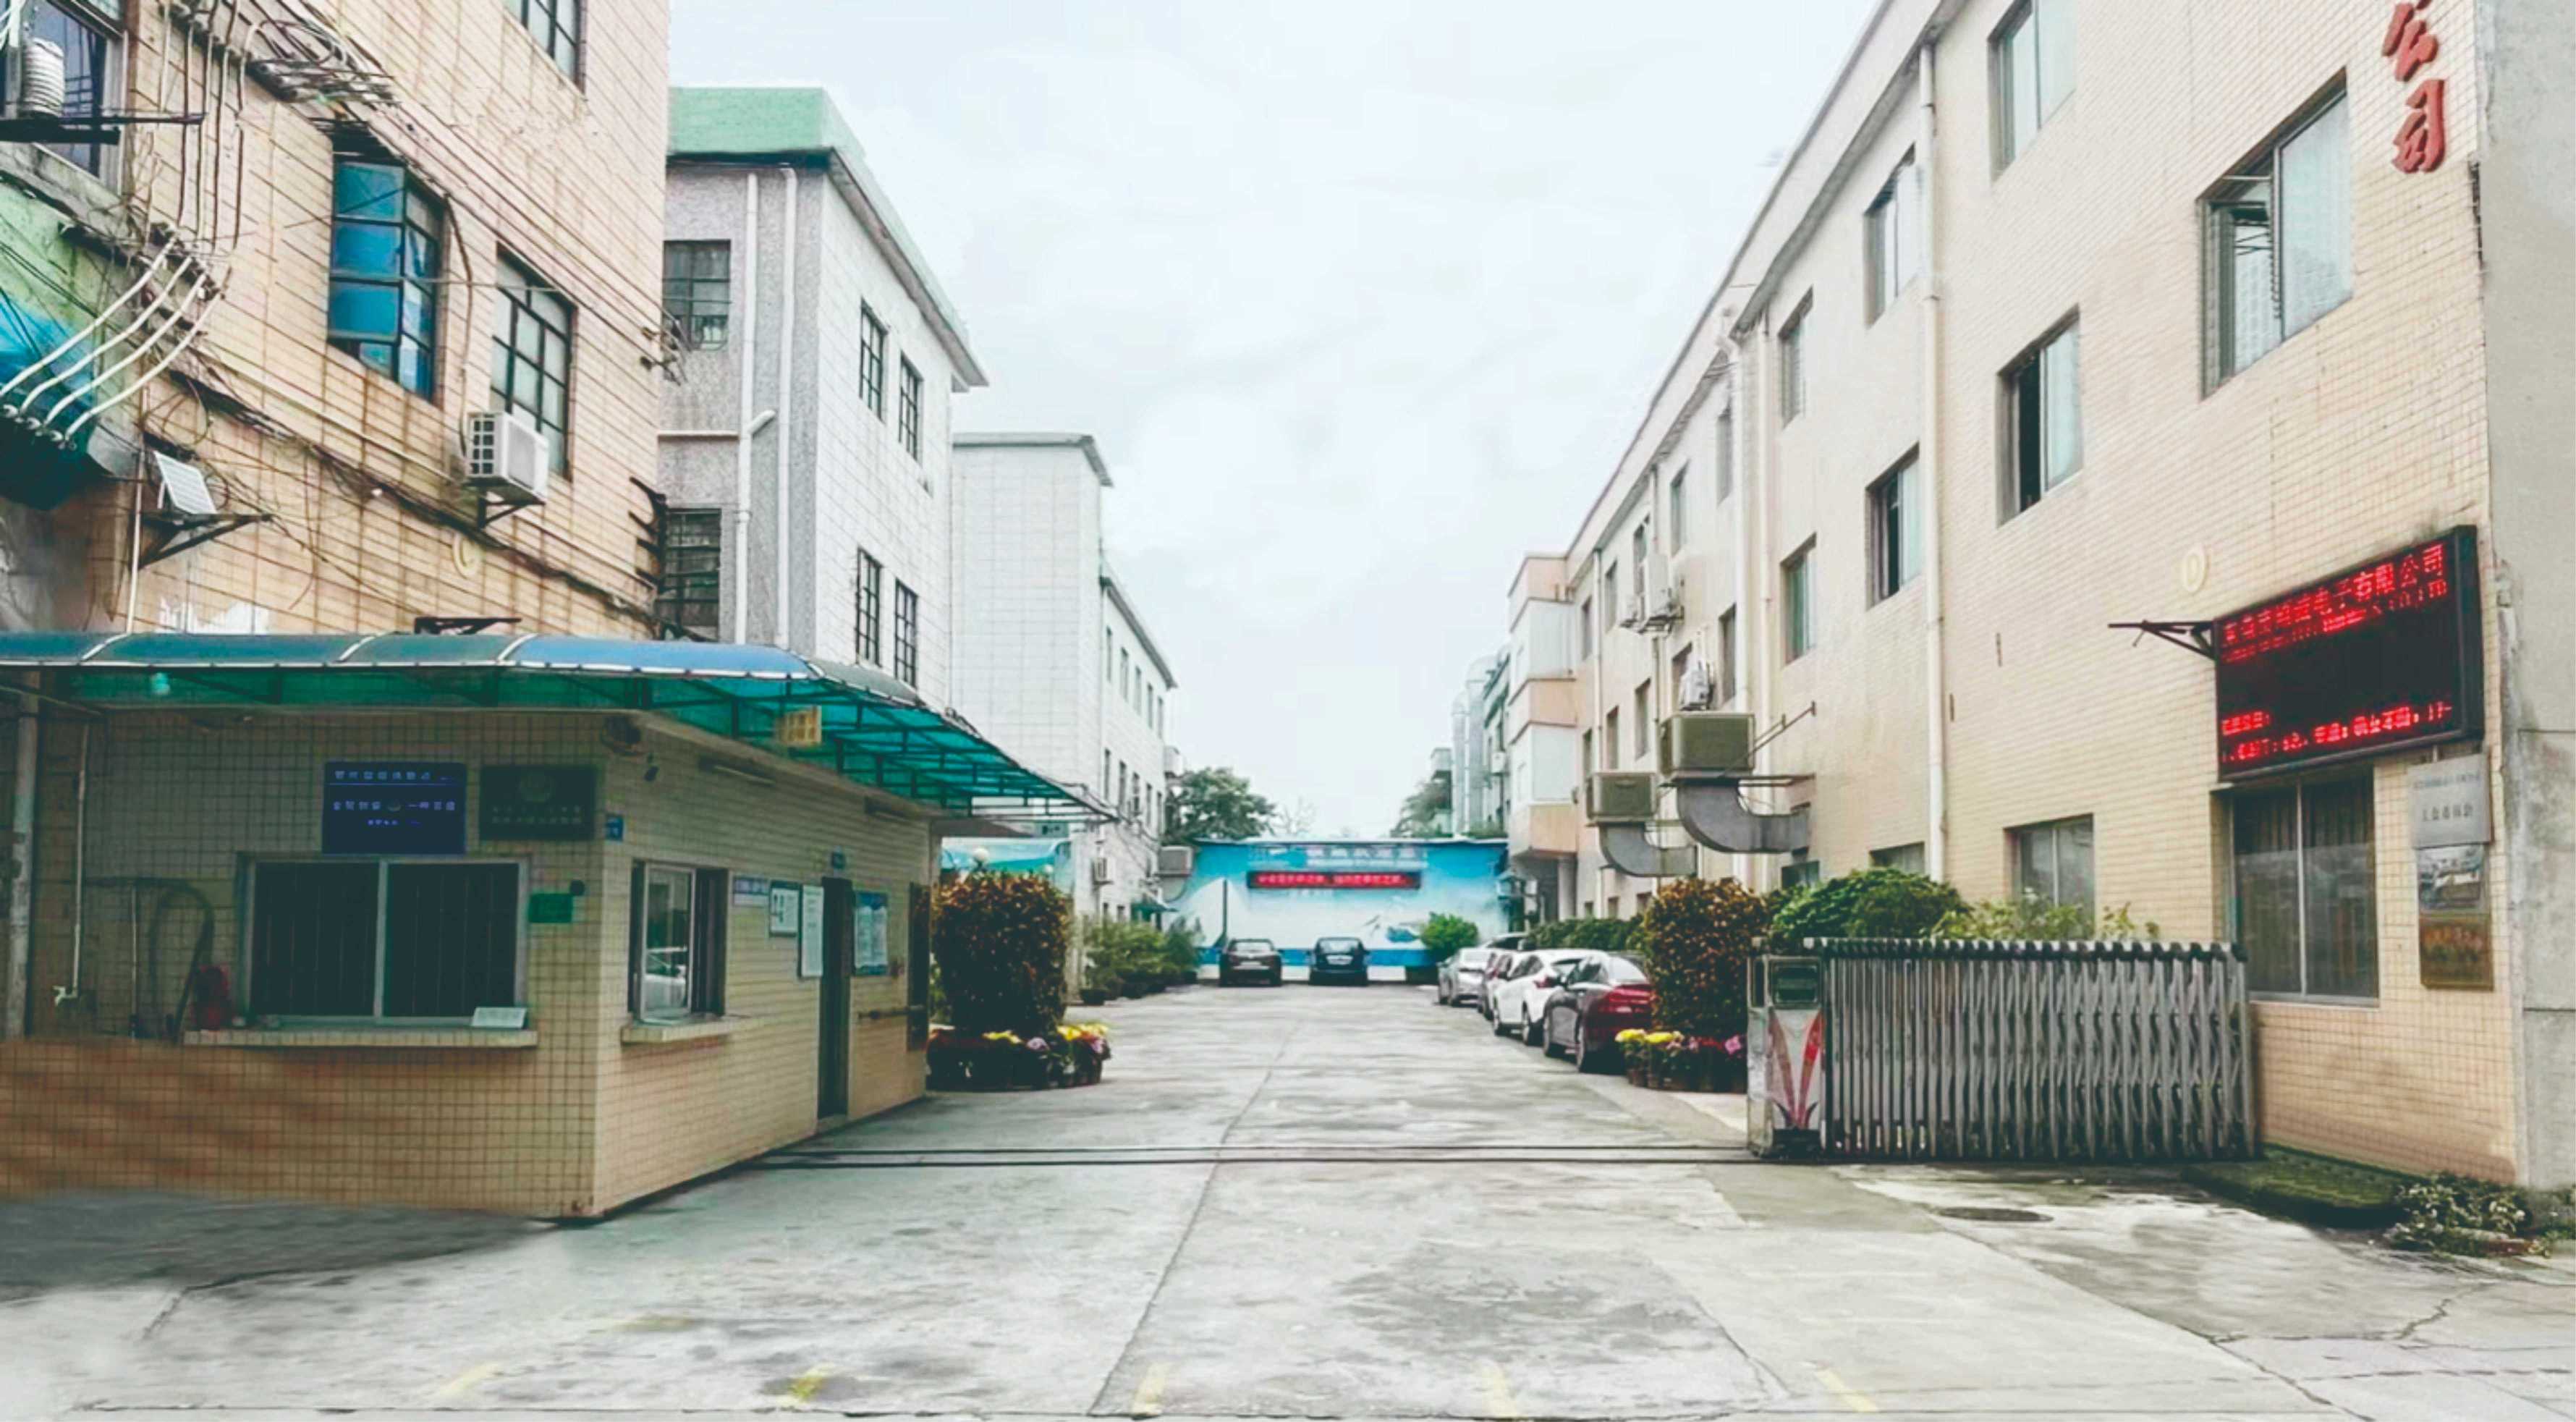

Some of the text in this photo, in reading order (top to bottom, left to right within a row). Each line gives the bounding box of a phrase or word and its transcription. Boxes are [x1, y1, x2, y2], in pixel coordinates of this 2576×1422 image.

[2383, 0, 2445, 173] 公司
[2222, 543, 2444, 646] 电子有限公司
